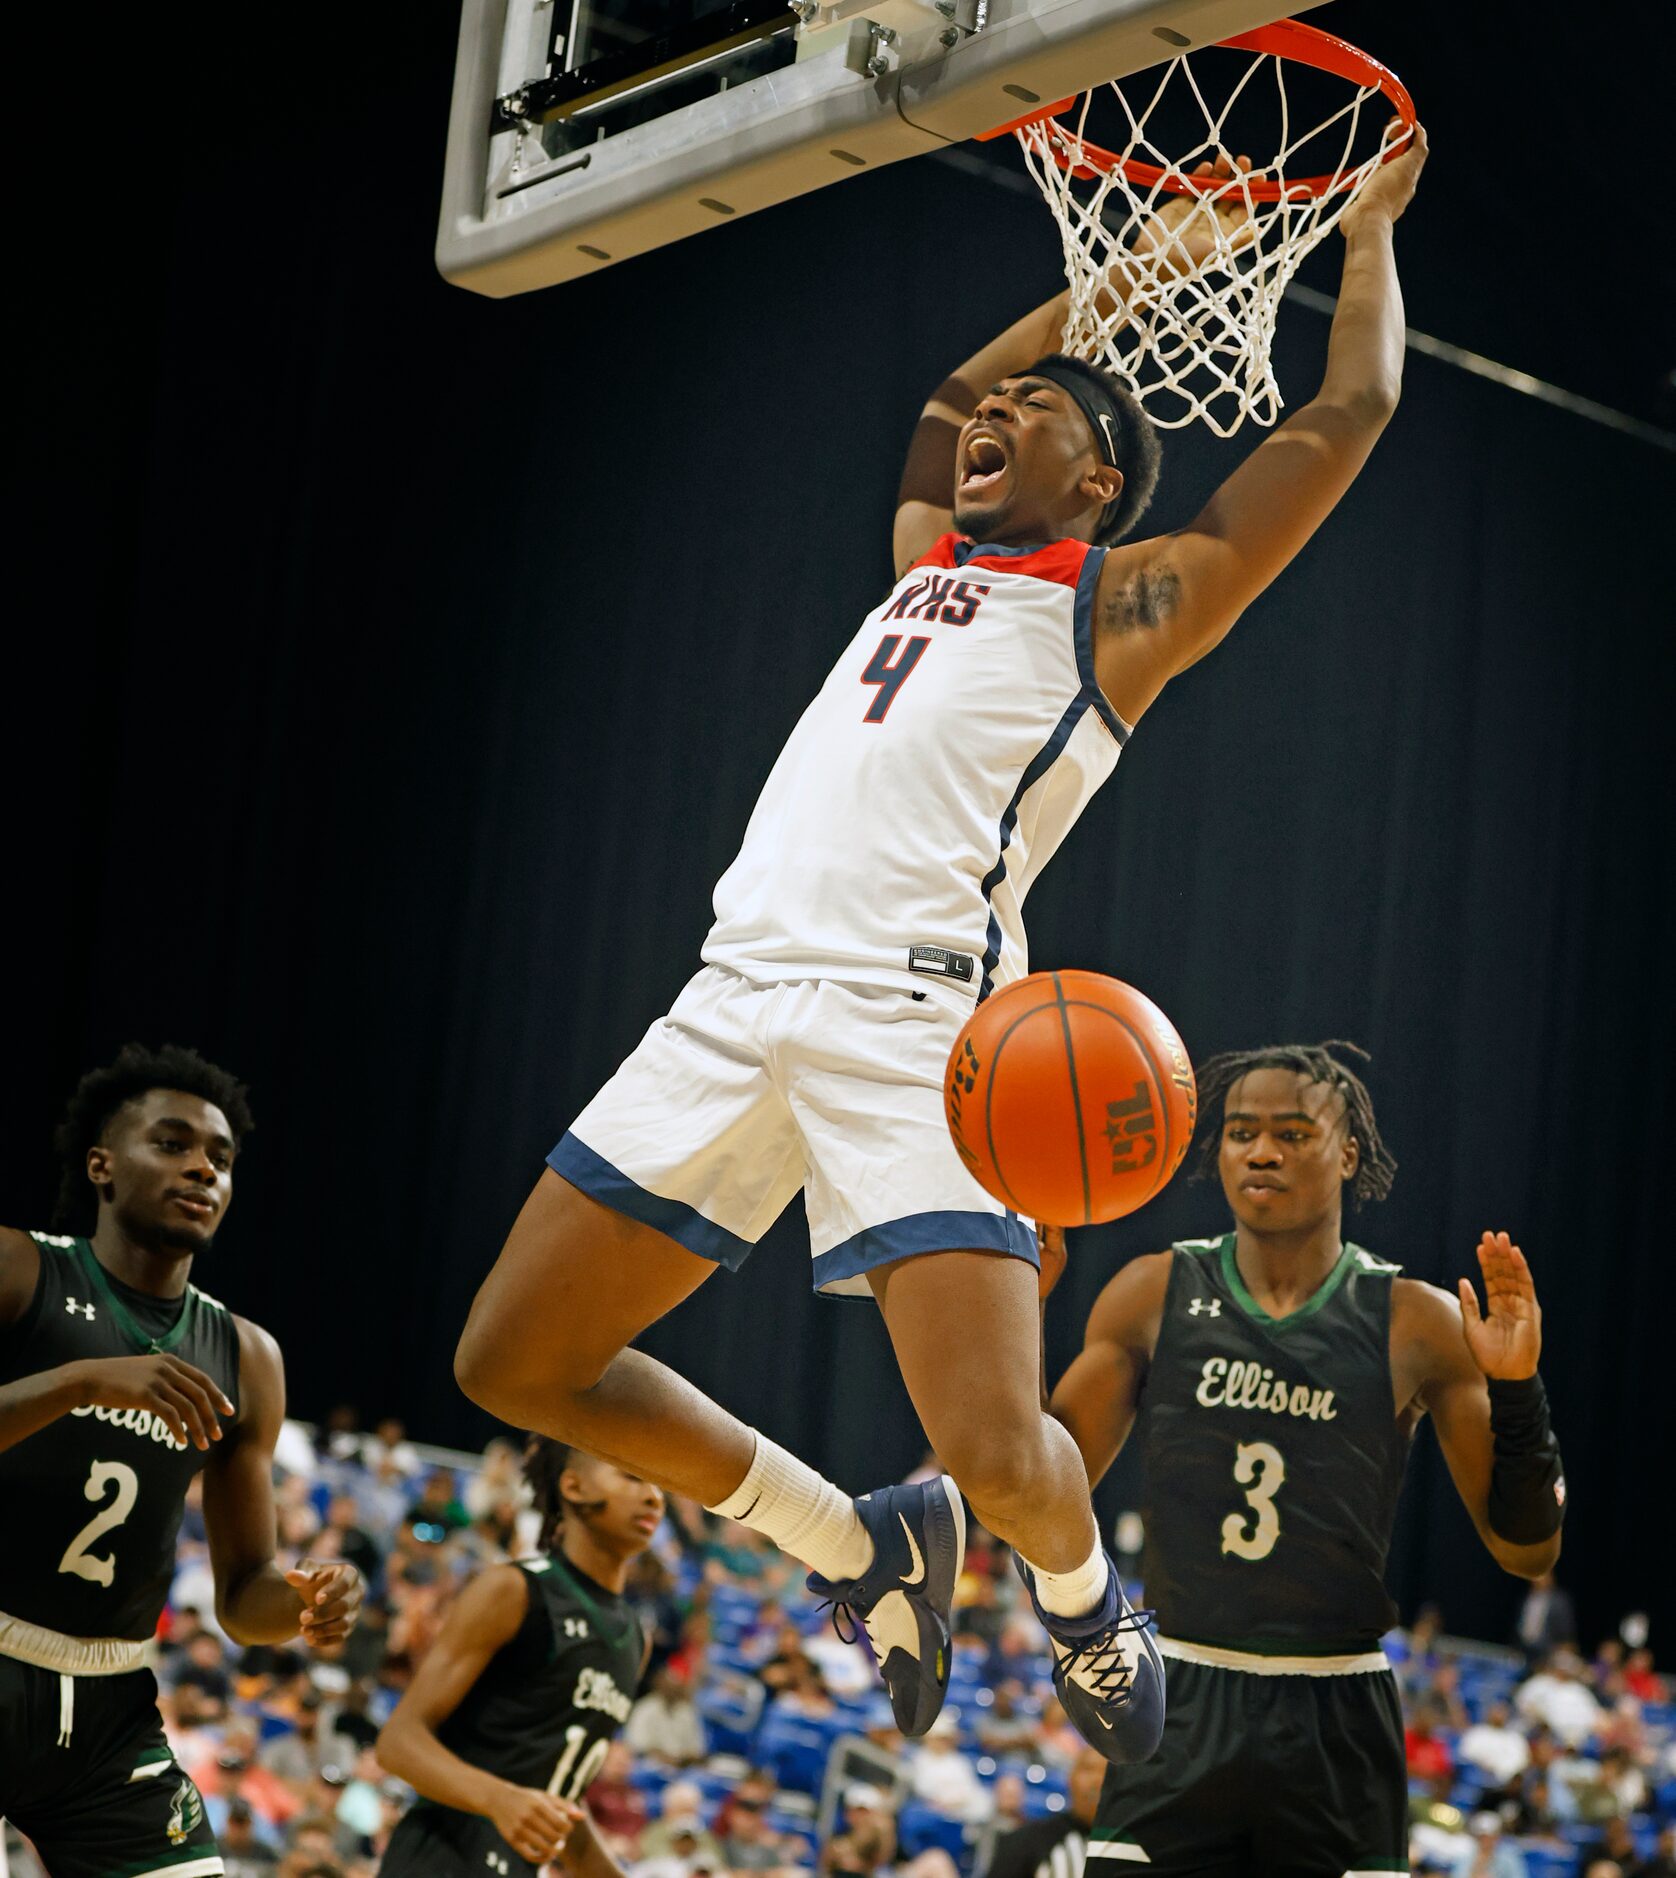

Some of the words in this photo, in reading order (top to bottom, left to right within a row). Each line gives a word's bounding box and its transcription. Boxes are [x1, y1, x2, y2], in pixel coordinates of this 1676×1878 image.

[860, 634, 932, 724] 4
[955, 959, 963, 971] L
[1104, 1080, 1157, 1175] UIL
[1196, 1357, 1337, 1421] Ellison
[58, 1459, 138, 1588] 2
[1221, 1442, 1285, 1560] 3
